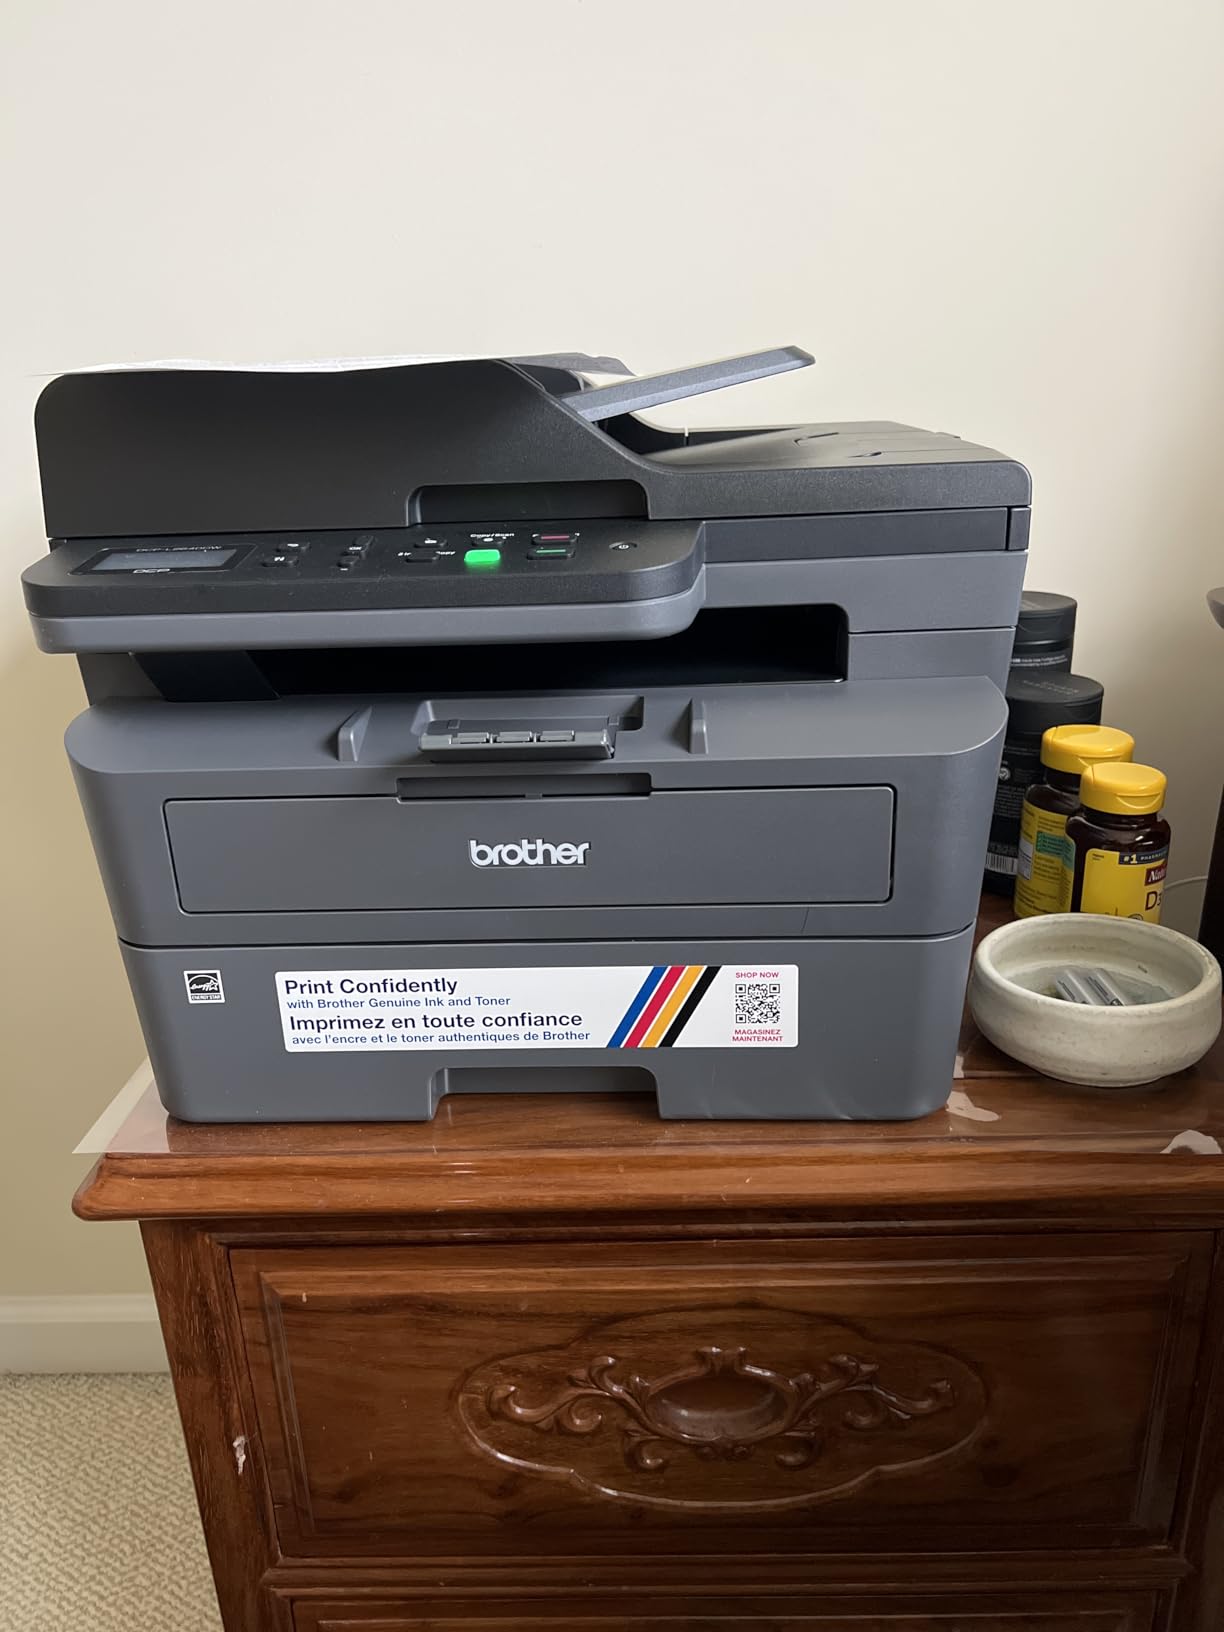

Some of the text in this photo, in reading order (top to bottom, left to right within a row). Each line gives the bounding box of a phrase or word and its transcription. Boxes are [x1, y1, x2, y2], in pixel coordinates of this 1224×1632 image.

[469, 839, 590, 866] brother
[285, 977, 458, 995] Print Confidently
[287, 996, 511, 1009] with Brother Genuine Ink and Toner
[290, 1012, 583, 1033] Imprimez en toute confiance
[292, 1031, 591, 1044] avec l'encre et le toner authentiques de Brother
